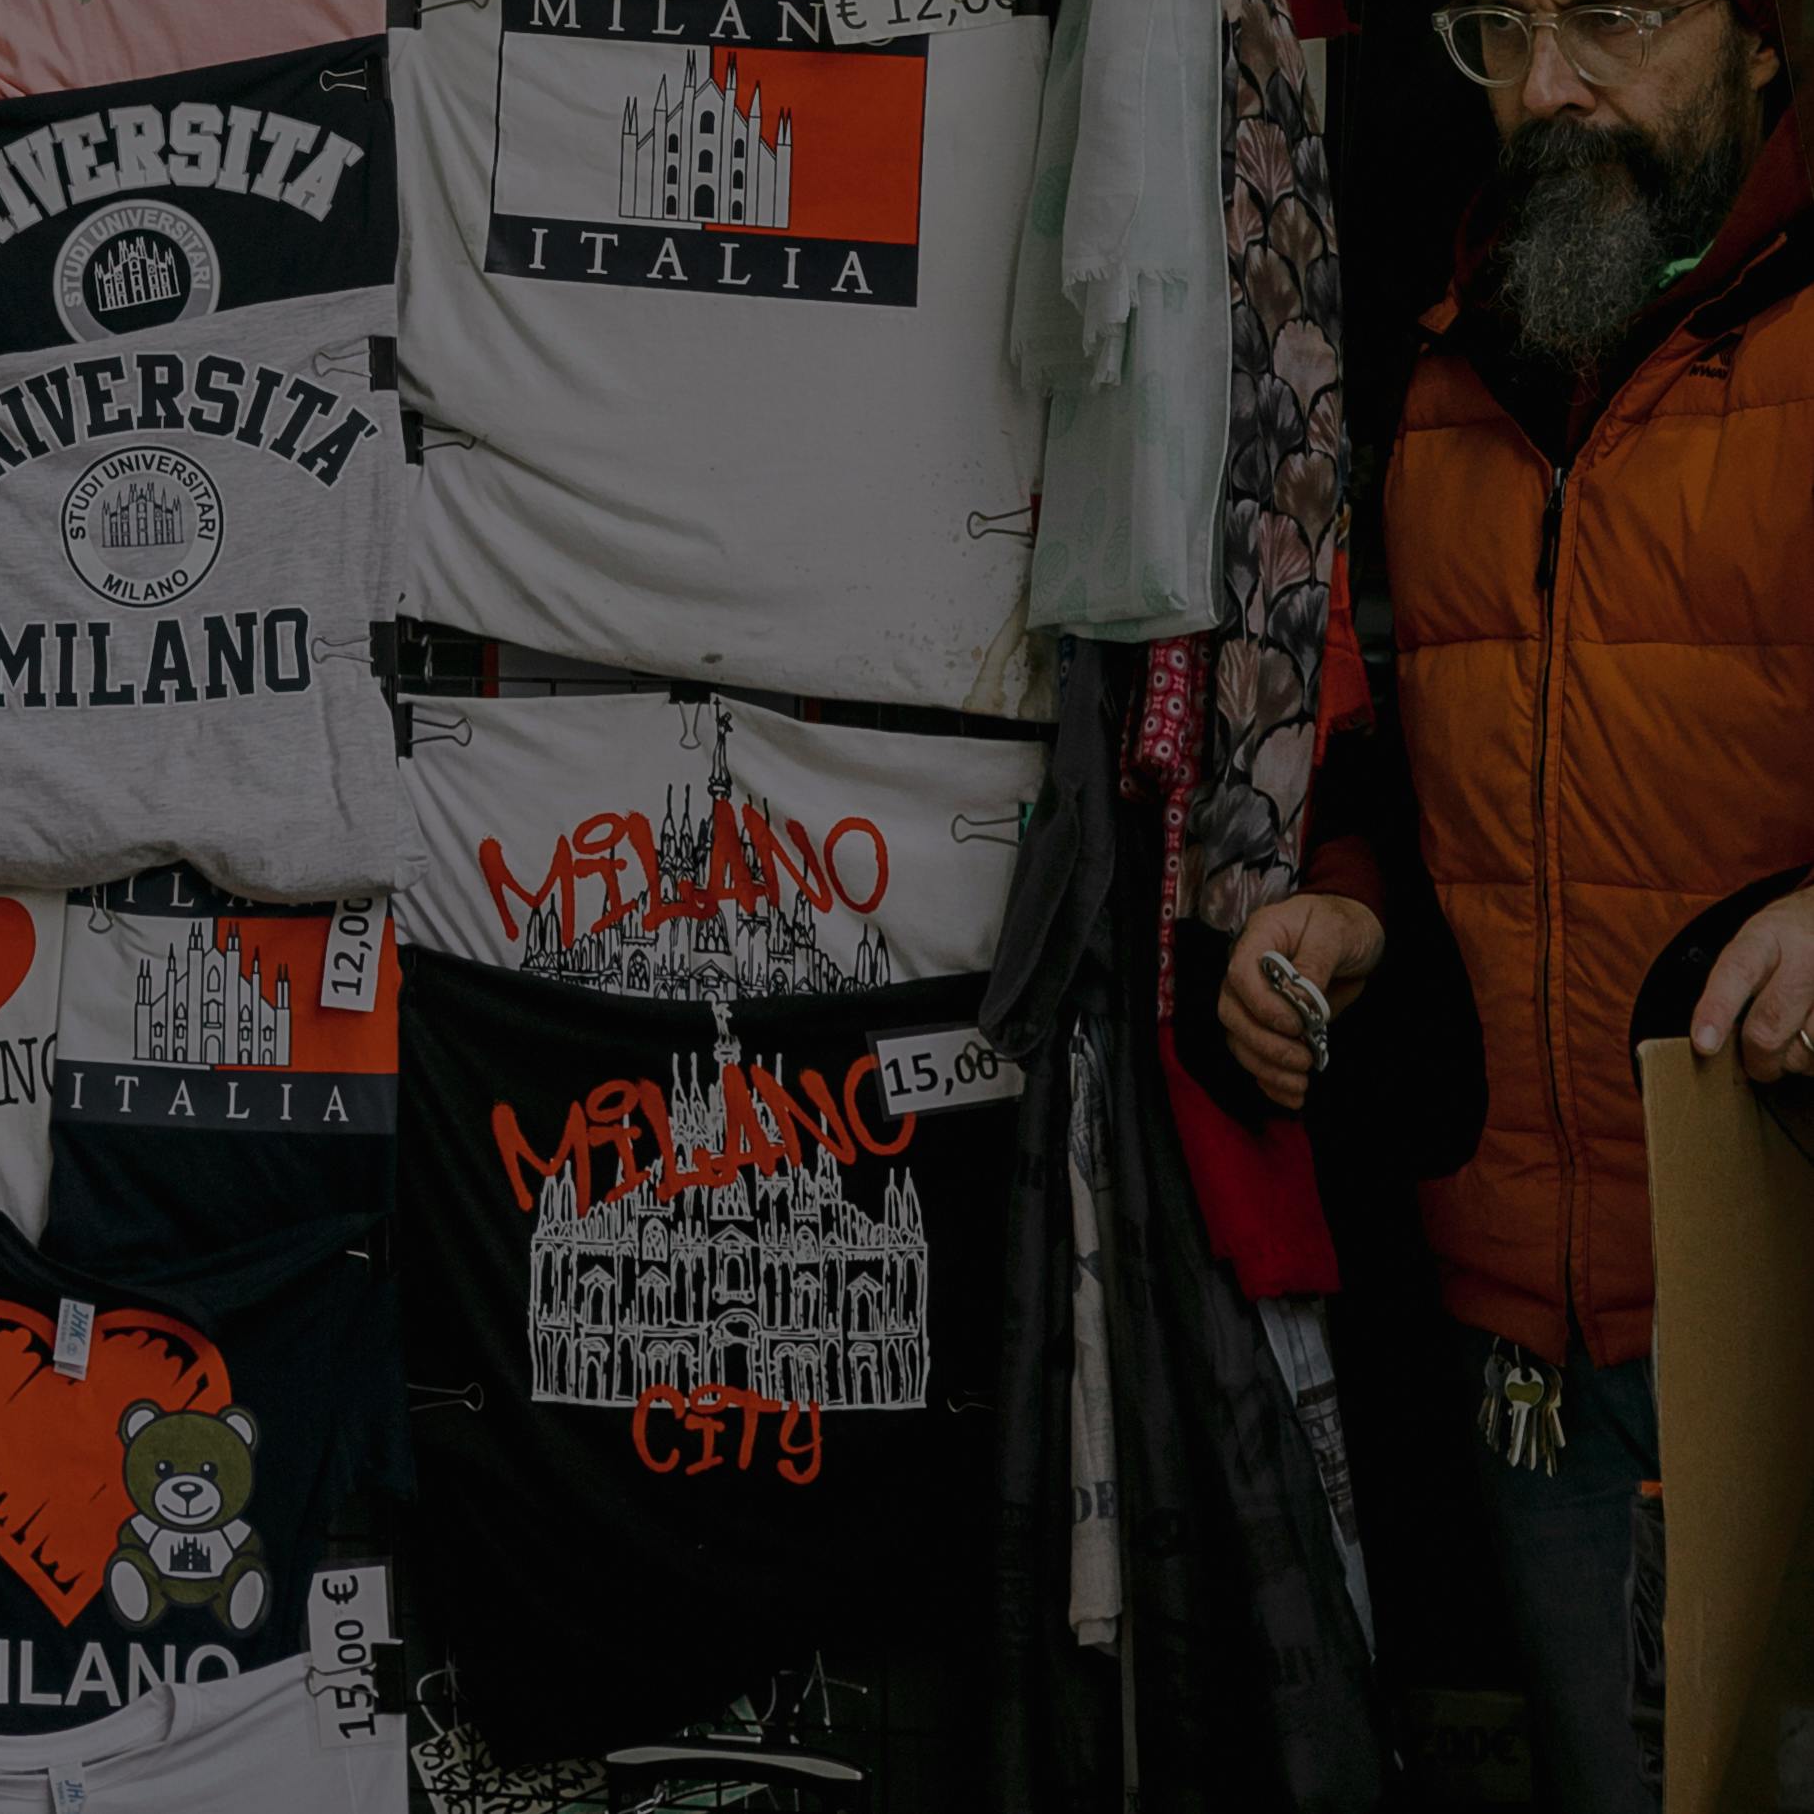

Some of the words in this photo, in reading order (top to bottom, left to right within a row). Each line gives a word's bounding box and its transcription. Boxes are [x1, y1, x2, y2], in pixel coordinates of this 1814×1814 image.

[62, 236, 92, 308] STUDI
[89, 208, 211, 290] UNIVERSITARI
[527, 227, 874, 297] ITALIA
[69, 481, 104, 539] STUDI
[104, 453, 216, 542] UNIVERSITARI
[102, 567, 189, 602] MILANO
[70, 1072, 349, 1123] ITALIA
[884, 1049, 999, 1097] 15,00
[321, 1574, 359, 1606] €
